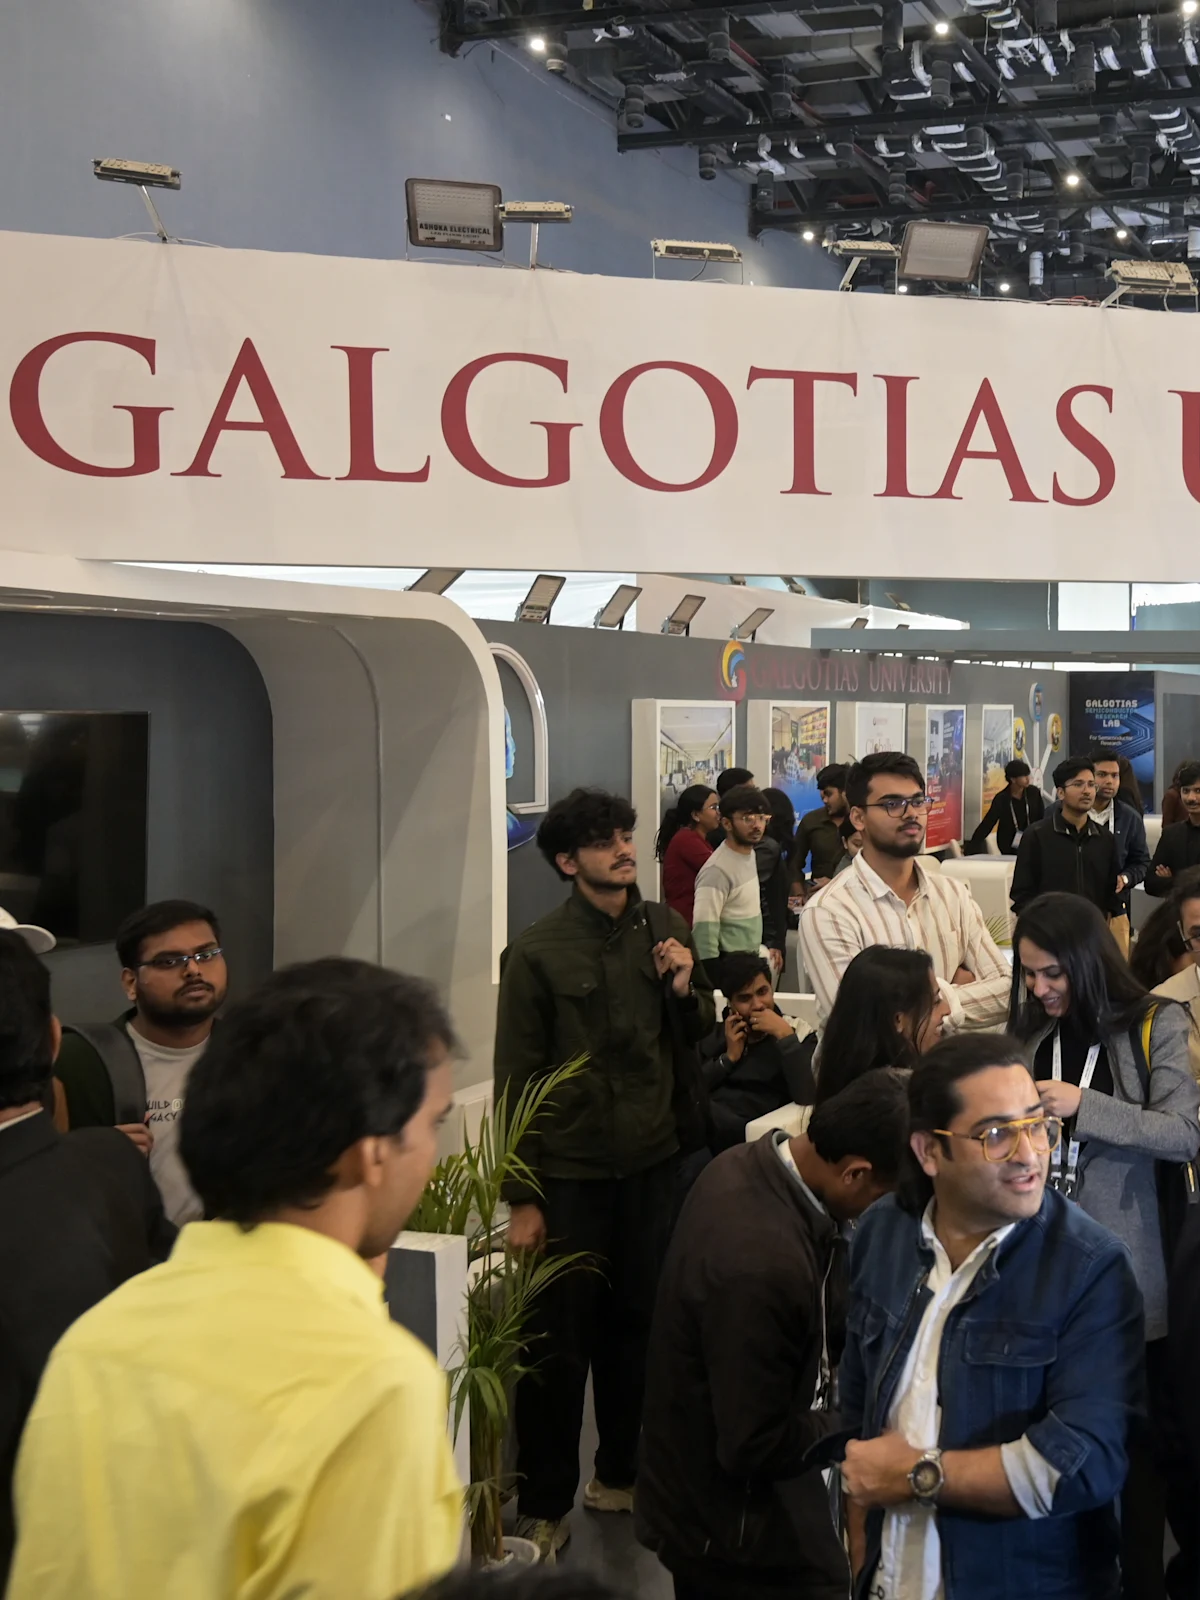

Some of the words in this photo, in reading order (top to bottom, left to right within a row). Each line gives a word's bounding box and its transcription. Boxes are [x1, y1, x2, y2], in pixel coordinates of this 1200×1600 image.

[419, 223, 448, 232] ASHOKA
[449, 225, 491, 235] ELECTRICAL
[10, 332, 1115, 505] GALGOTIAS
[869, 661, 952, 695] UNIVERSITY
[1085, 699, 1138, 708] GALGOTIAS
[1102, 720, 1121, 728] LAB
[148, 1100, 170, 1110] UILD
[149, 1111, 178, 1122] GACY
